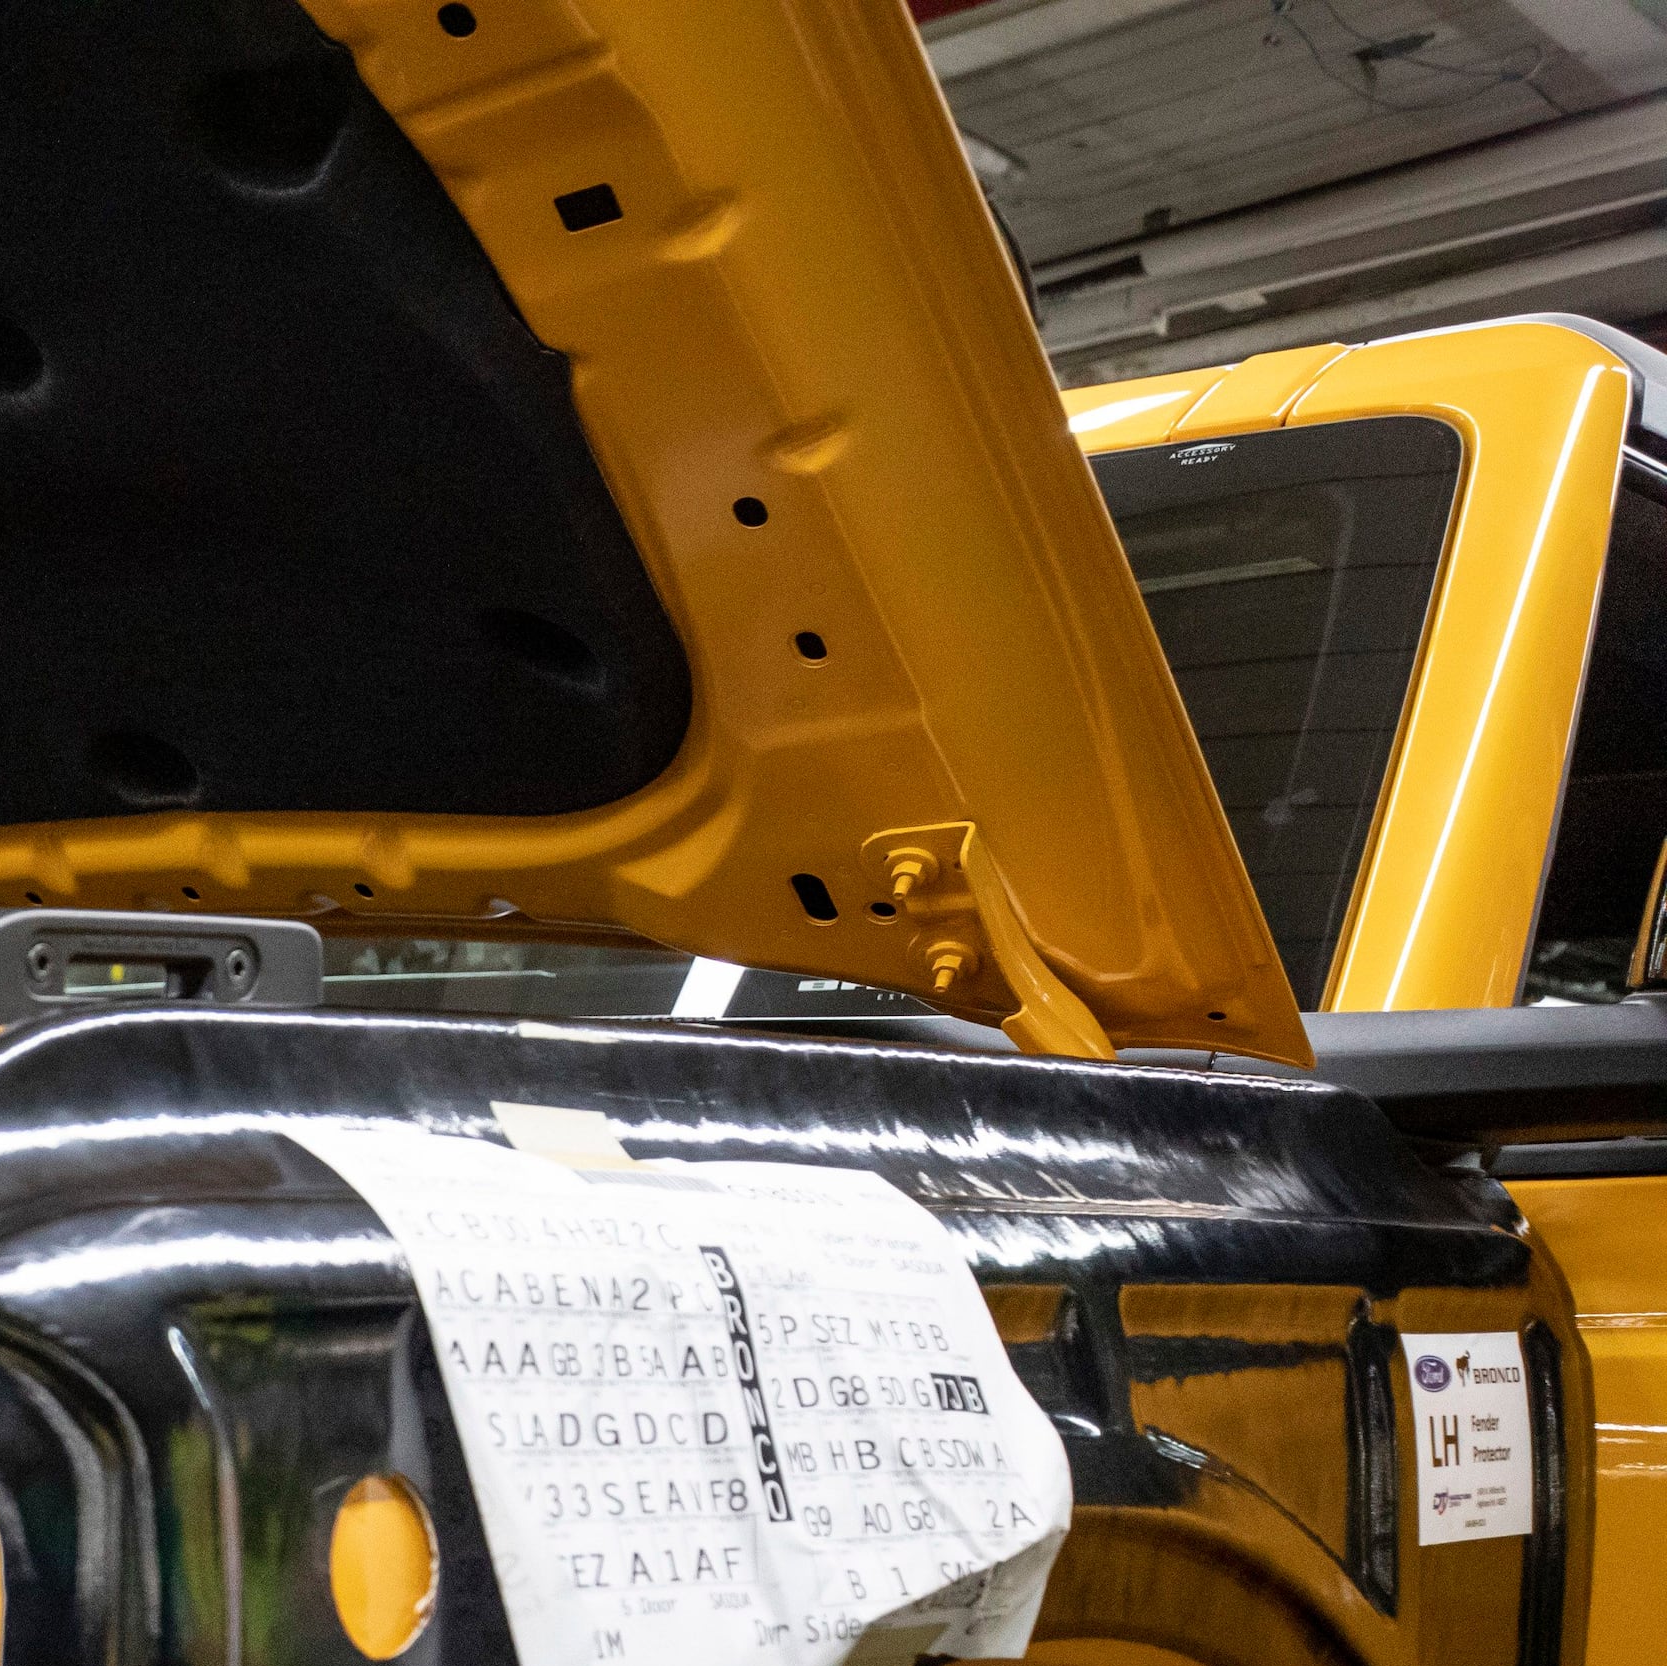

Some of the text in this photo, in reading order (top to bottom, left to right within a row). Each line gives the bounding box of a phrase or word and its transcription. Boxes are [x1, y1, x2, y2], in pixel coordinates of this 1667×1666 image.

[1169, 443, 1236, 460] ACCESSORY
[1180, 454, 1218, 466] READY
[1473, 1366, 1521, 1385] BRONCO
[1470, 1413, 1500, 1432] Fender
[1429, 1414, 1460, 1468] LH
[1473, 1445, 1511, 1464] Protector
